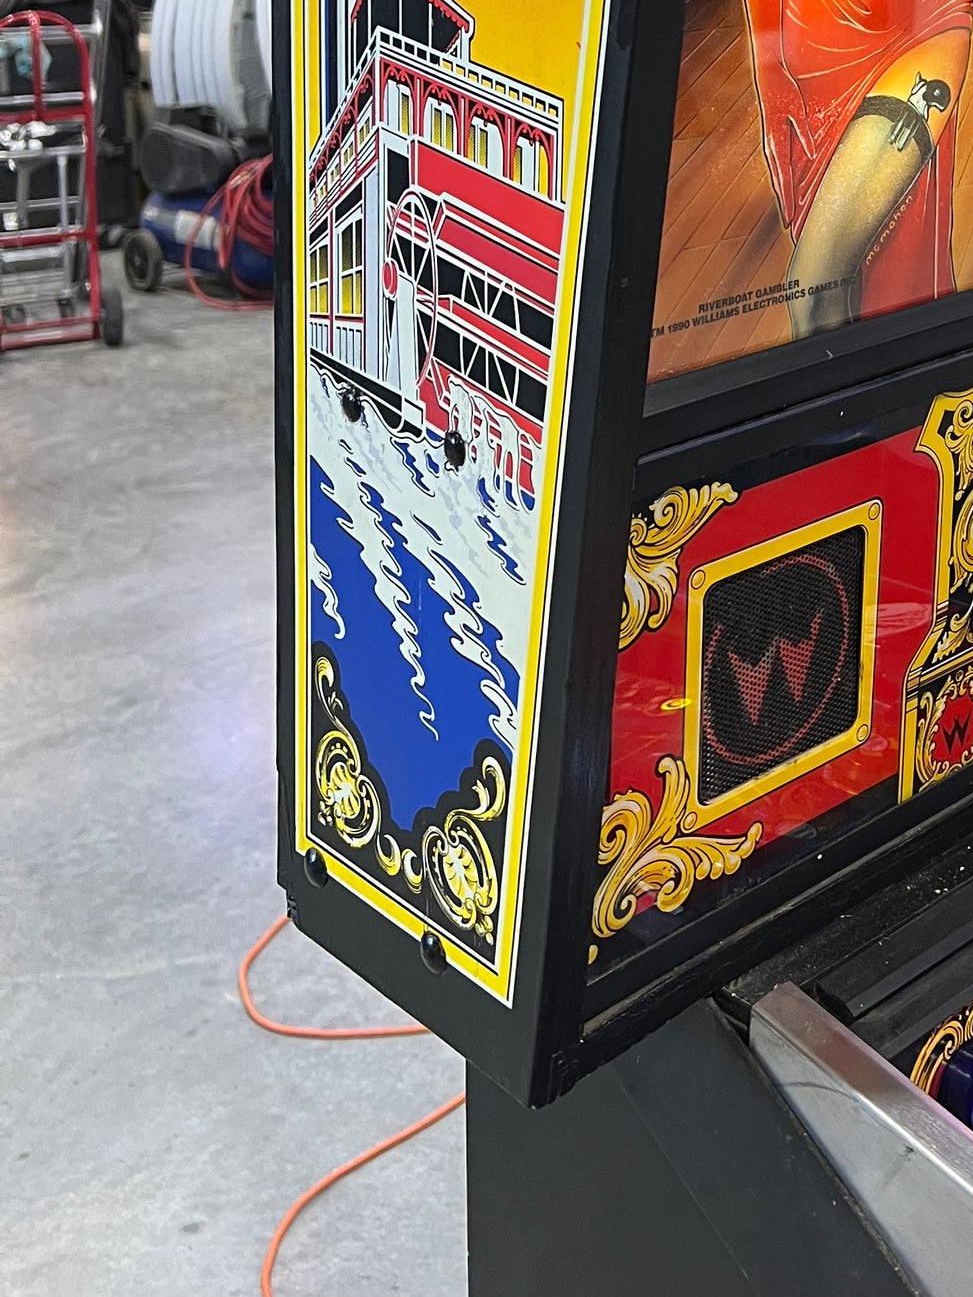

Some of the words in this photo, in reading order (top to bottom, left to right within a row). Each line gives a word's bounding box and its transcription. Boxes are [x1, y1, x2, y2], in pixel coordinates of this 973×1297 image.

[668, 319, 690, 333] 1990
[692, 307, 740, 326] WILLIAMS
[742, 290, 805, 314] ELECTRONICS
[808, 281, 839, 295] GAMES
[698, 292, 753, 313] RIVERBOAT
[755, 279, 800, 298] GAMBLER
